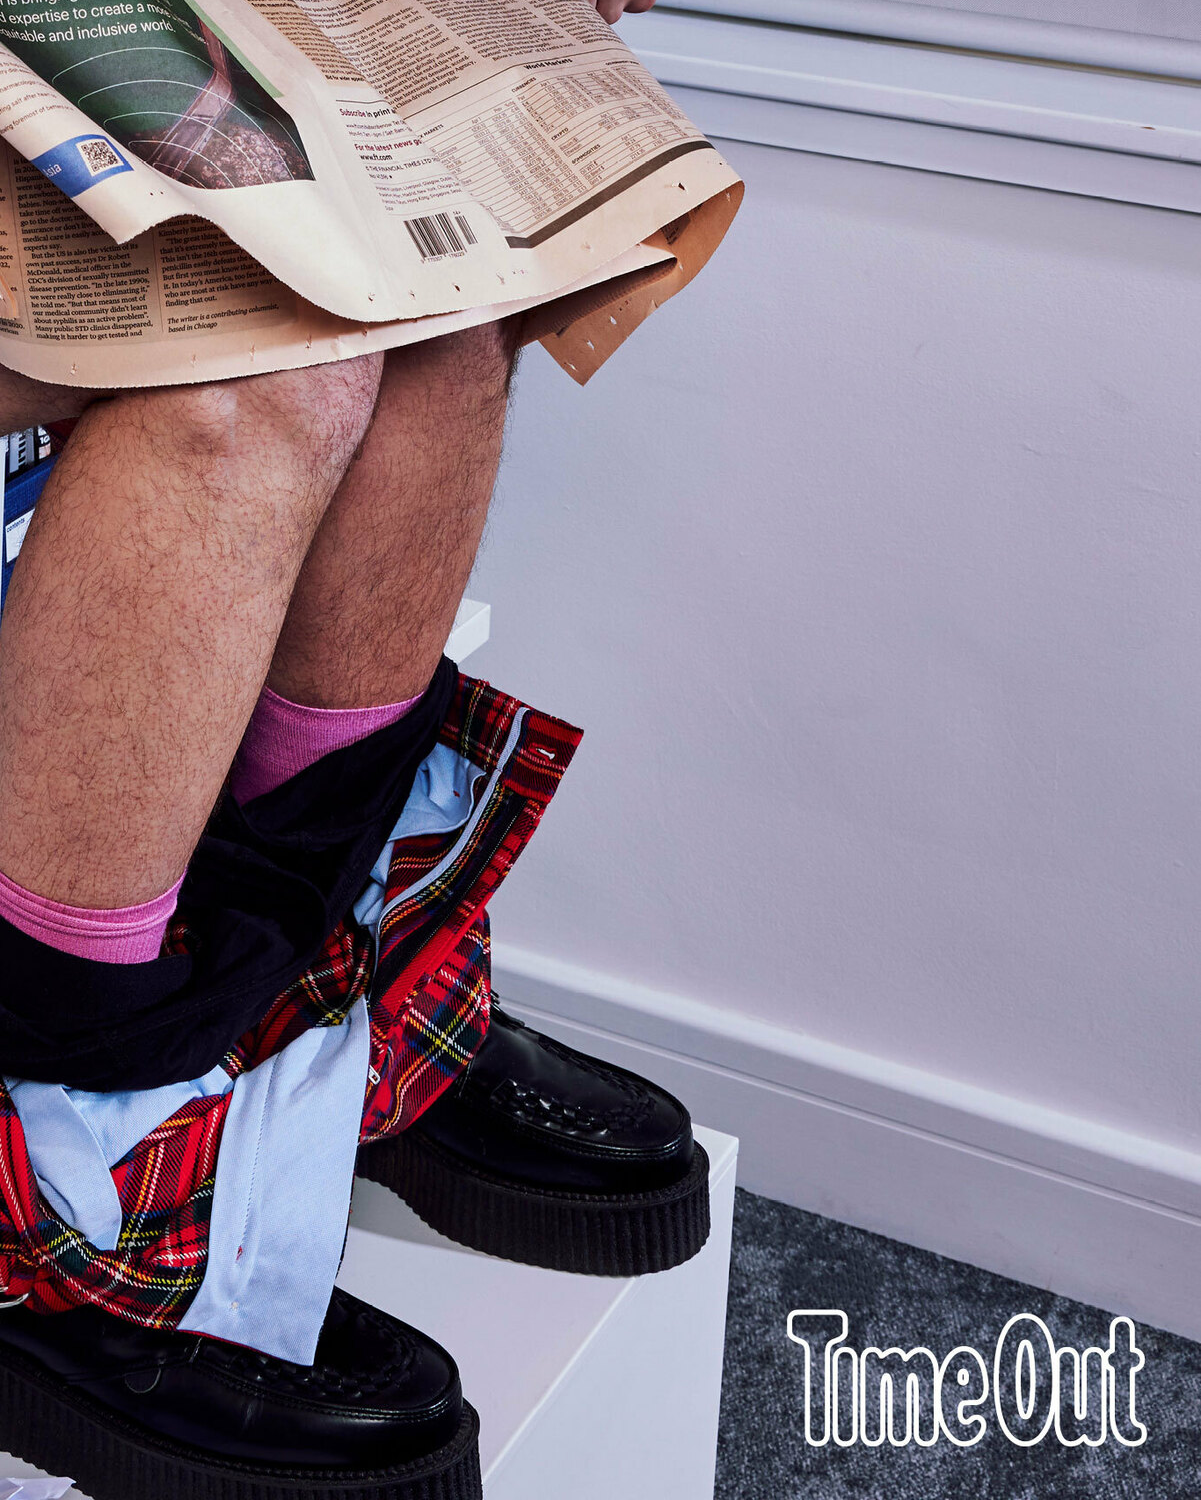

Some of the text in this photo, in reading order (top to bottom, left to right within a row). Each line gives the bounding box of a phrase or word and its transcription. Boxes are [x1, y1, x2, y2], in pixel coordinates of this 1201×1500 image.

[8, 10, 70, 27] expertise
[72, 7, 89, 20] to
[90, 2, 134, 17] create
[136, 2, 146, 13] a
[48, 27, 75, 42] and
[76, 21, 138, 40] inclusive
[523, 57, 573, 70] World Markets
[340, 108, 391, 119] Subscribe in print
[423, 124, 444, 138] MARKETS
[551, 127, 569, 142] CRYPTO
[354, 143, 364, 151] For
[365, 143, 374, 151] the
[374, 143, 393, 151] latest
[393, 140, 413, 149] news
[404, 161, 421, 169] TIMES
[167, 317, 180, 325] The
[180, 315, 199, 323] writer
[210, 308, 248, 319] contributing
[248, 303, 280, 314] columnist,
[35, 325, 53, 334] Many
[54, 325, 74, 333] public
[90, 323, 111, 331] clinics
[111, 320, 154, 330] disappeared,
[168, 325, 186, 333] based
[193, 321, 218, 331] Chicago
[36, 332, 60, 341] making
[66, 332, 88, 340] harder
[97, 332, 108, 341] get
[108, 330, 129, 339] tested
[129, 329, 143, 337] and
